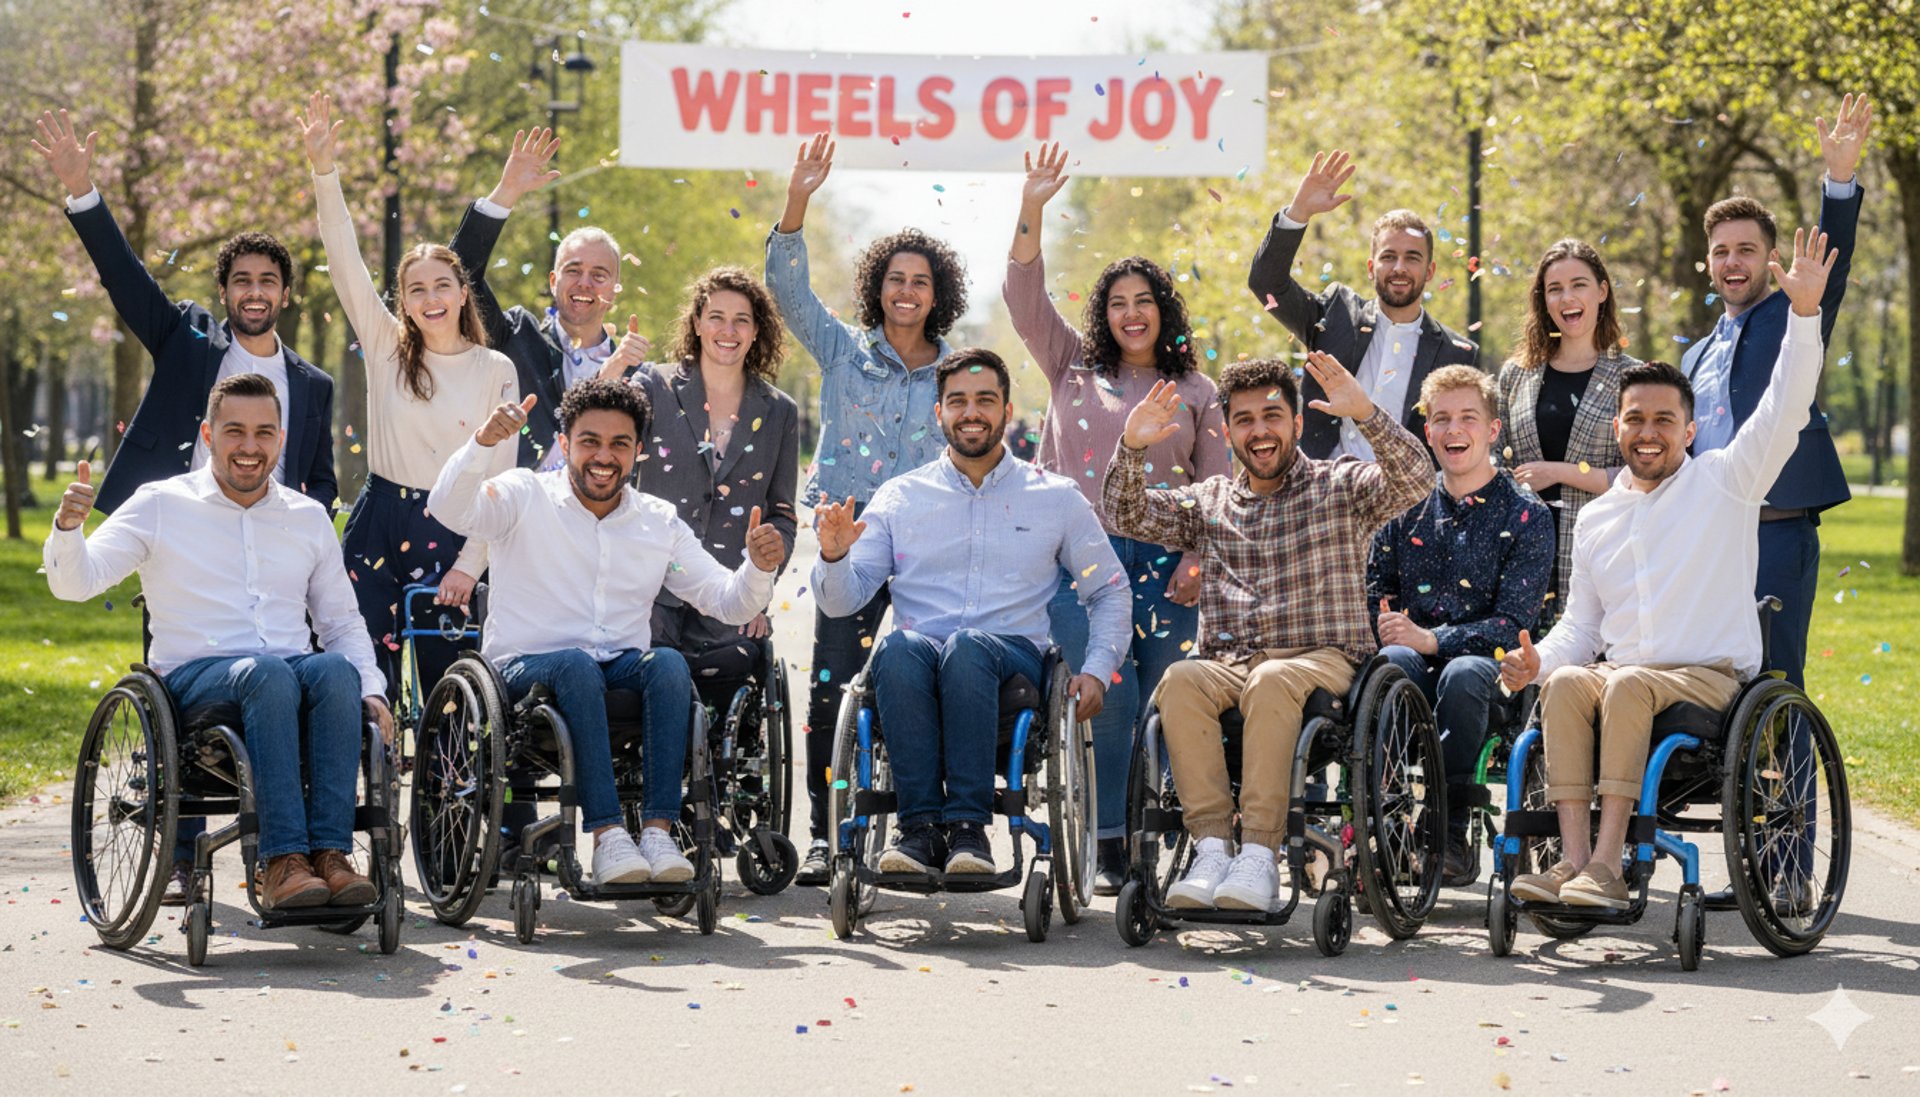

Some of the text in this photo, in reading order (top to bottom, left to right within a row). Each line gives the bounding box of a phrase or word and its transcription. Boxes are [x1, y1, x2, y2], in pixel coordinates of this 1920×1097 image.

[671, 67, 1224, 141] WHEELS OF JOY
